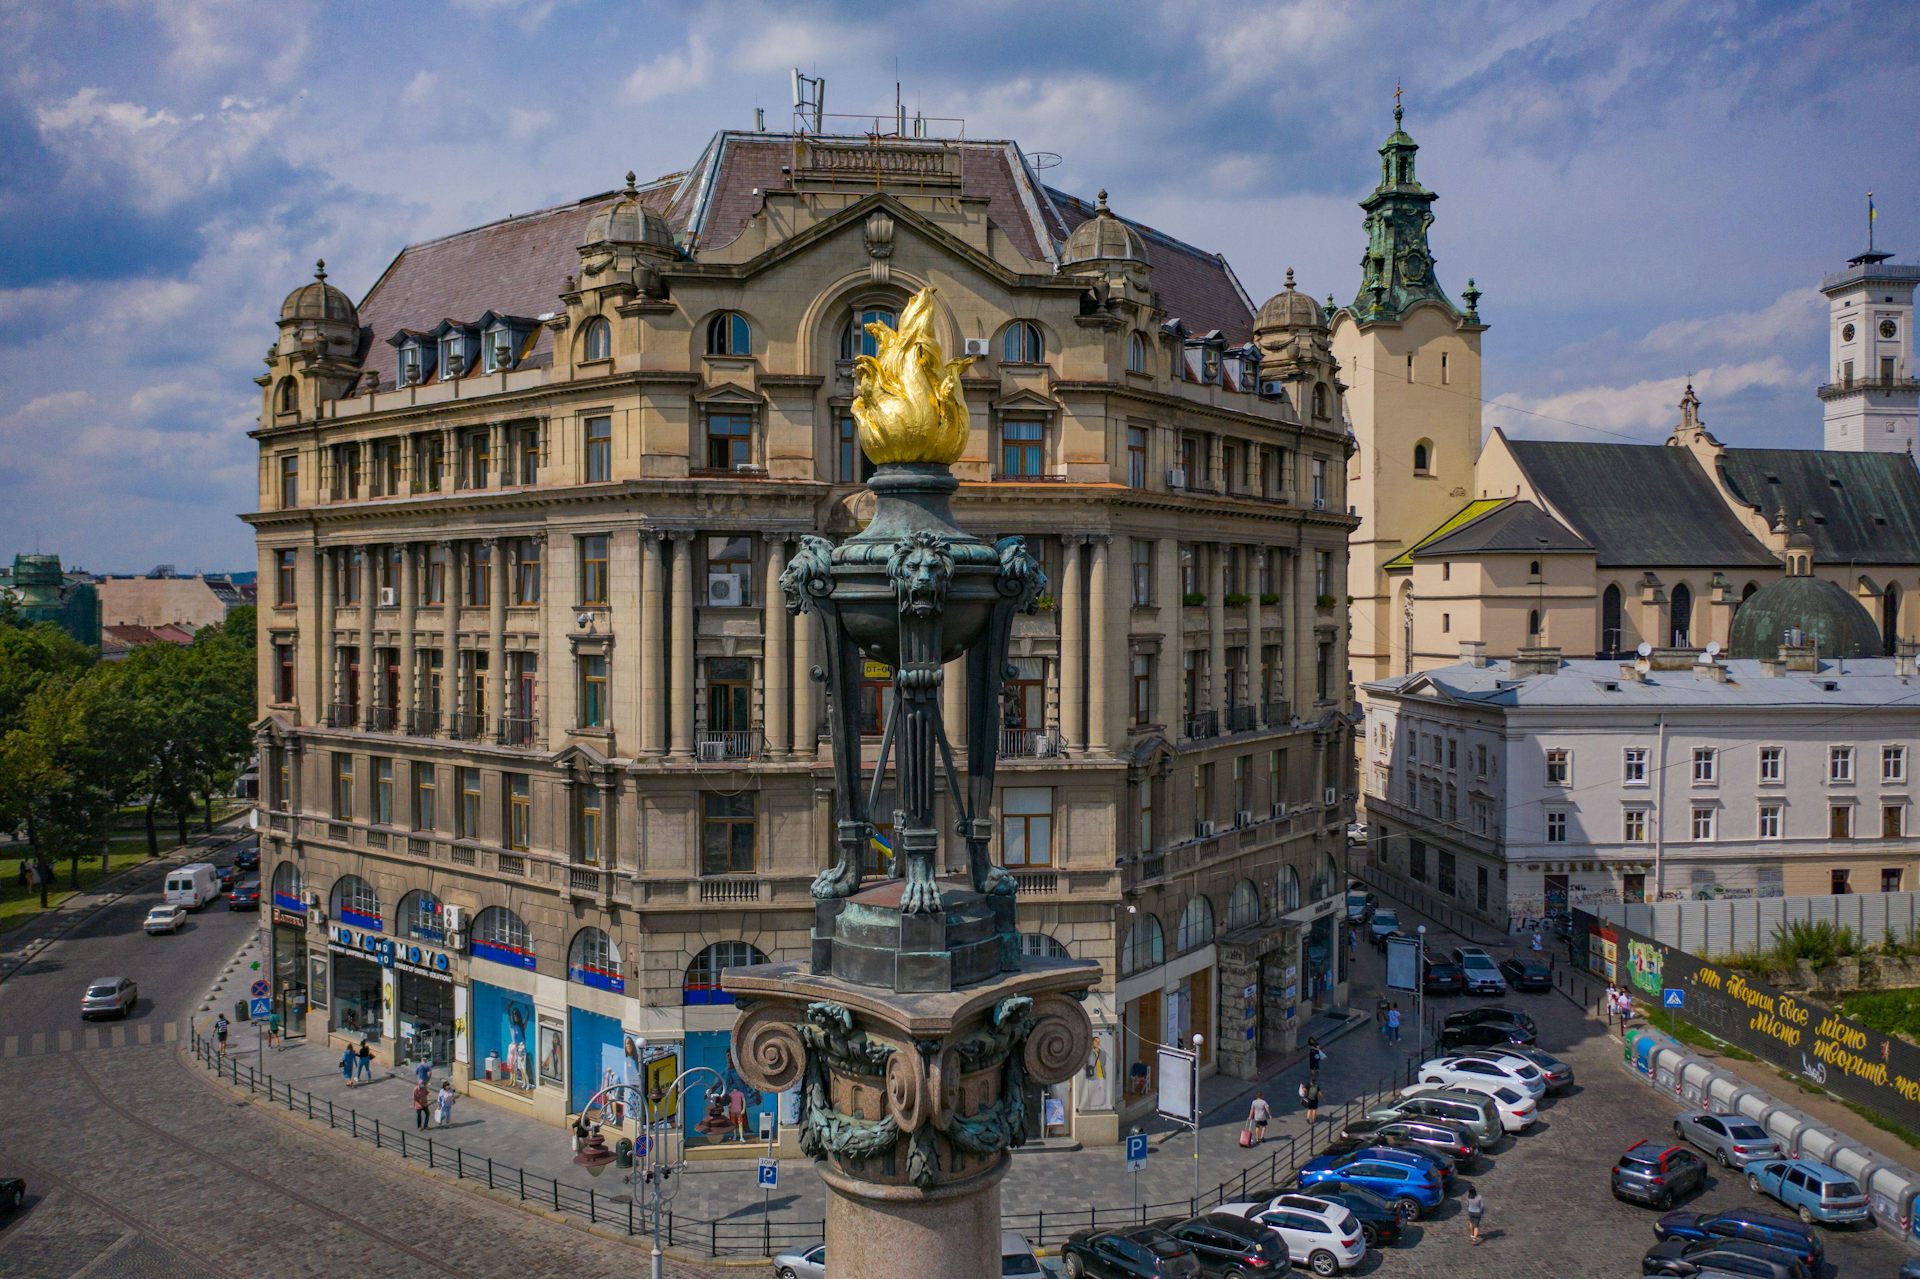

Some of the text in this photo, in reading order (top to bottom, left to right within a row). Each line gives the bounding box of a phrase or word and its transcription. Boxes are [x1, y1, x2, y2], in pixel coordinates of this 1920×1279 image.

[329, 926, 375, 951] MOYO
[397, 943, 448, 970] MOYO
[1895, 1075, 1920, 1103] те
[1131, 1139, 1142, 1157] P
